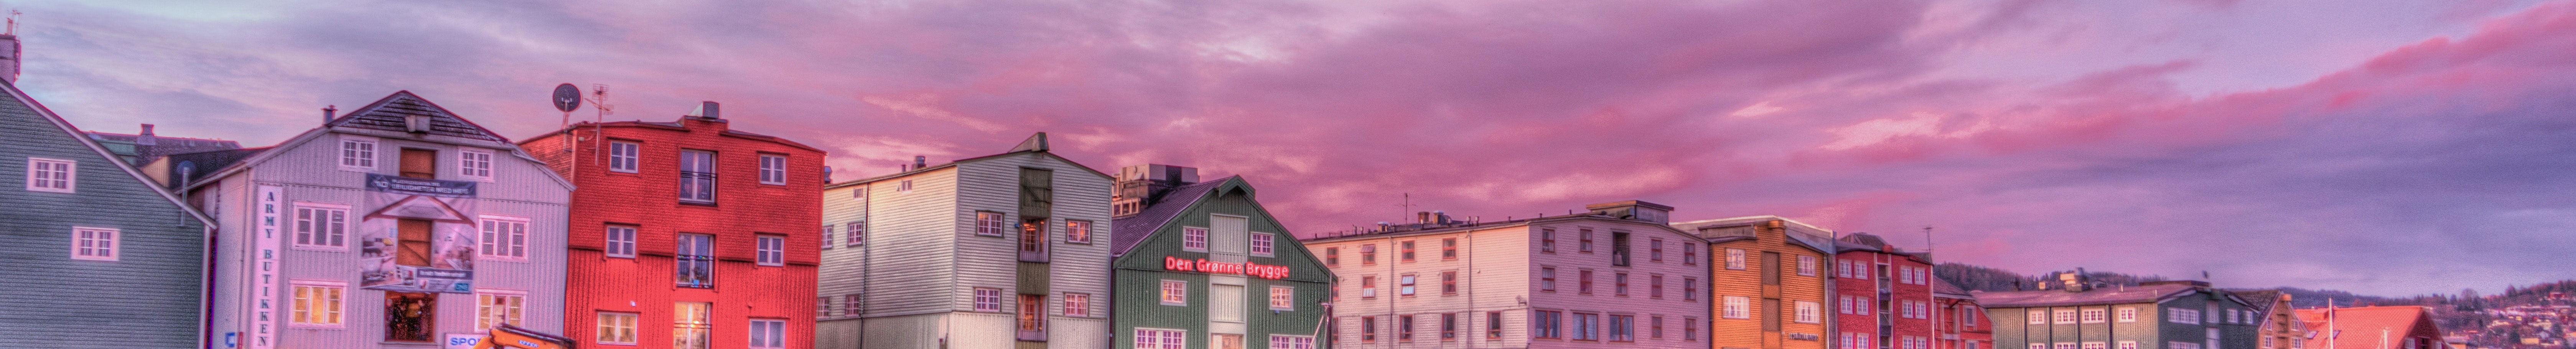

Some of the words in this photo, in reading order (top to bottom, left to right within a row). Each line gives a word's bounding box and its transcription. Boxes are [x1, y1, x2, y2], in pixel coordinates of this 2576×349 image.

[265, 192, 275, 238] ARMY
[1166, 256, 1192, 271] Den
[1196, 258, 1243, 274] Grønne
[1246, 261, 1289, 279] Brygge
[258, 250, 272, 346] BUTIKKEN
